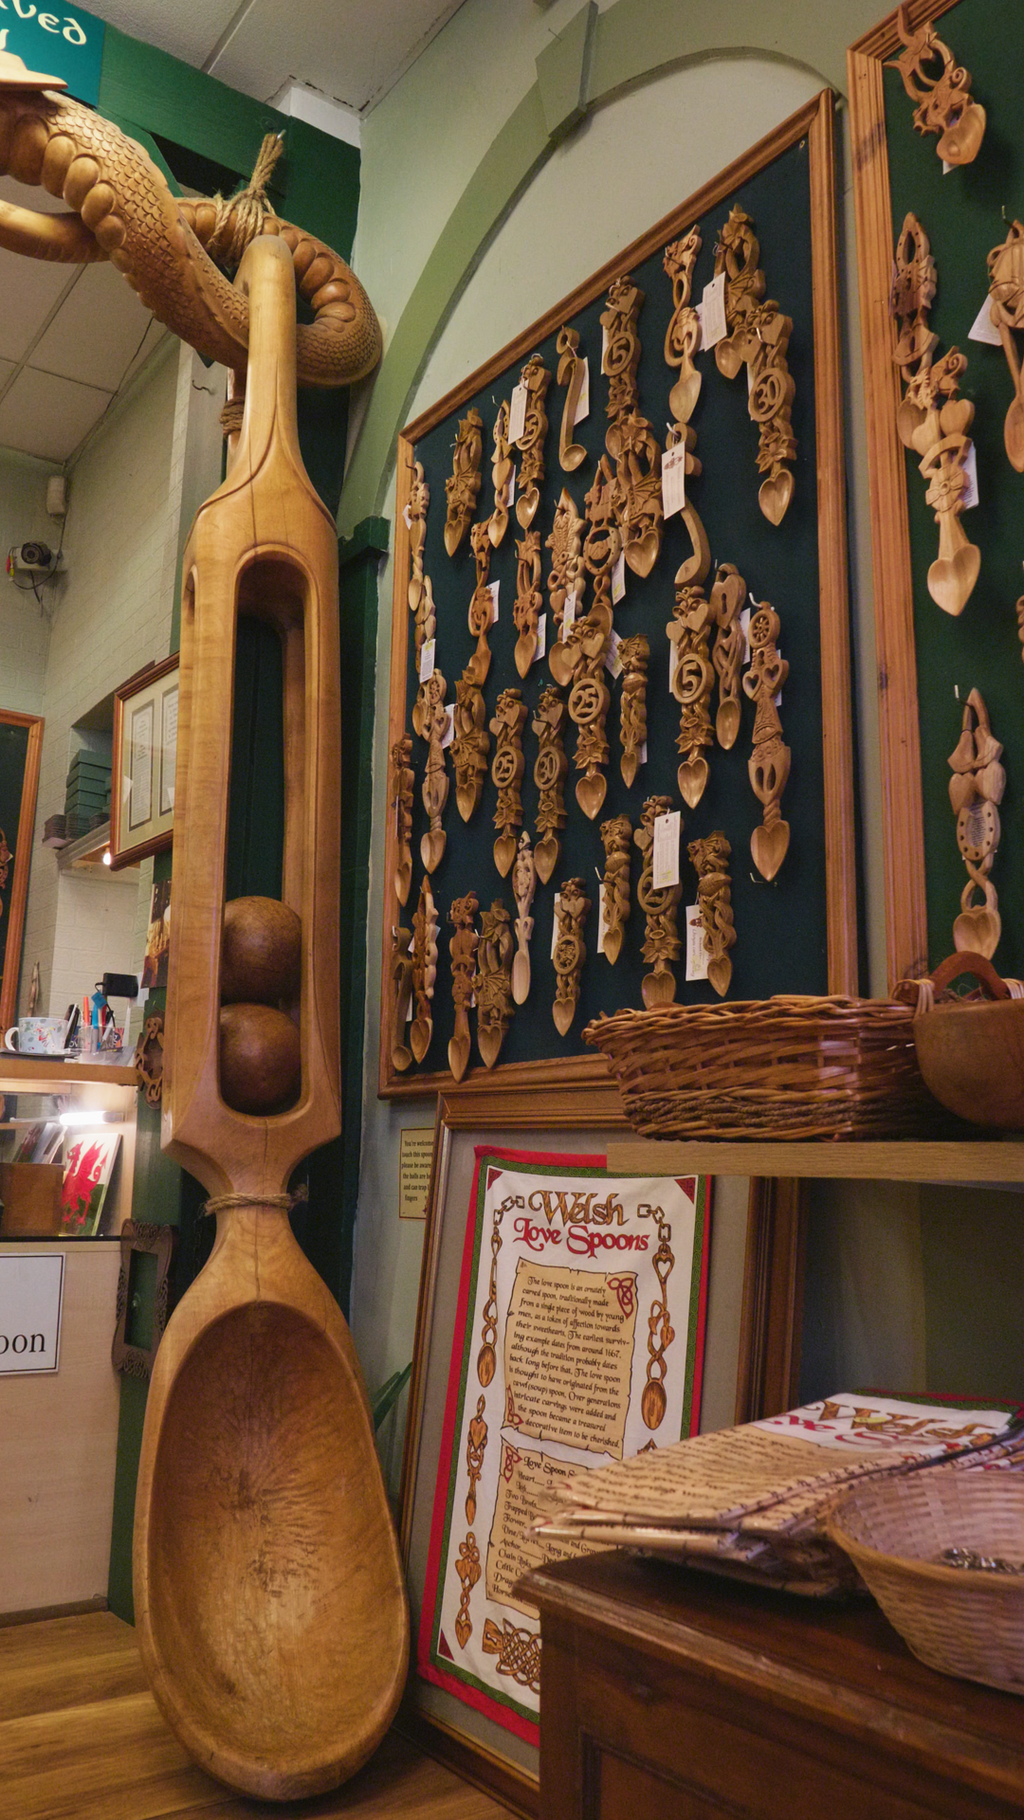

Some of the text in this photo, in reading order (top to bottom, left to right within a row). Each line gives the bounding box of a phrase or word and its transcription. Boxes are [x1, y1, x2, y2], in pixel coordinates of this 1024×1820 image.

[528, 1190, 630, 1226] Welsh
[513, 1218, 650, 1259] Love Spoons
[522, 1288, 609, 1308] carved spoon, traditionally made
[528, 1276, 540, 1285] The
[542, 1280, 552, 1288] love
[554, 1282, 569, 1292] spoon
[584, 1284, 606, 1297] ornately
[518, 1310, 532, 1320] men,
[547, 1315, 561, 1324] token
[563, 1316, 568, 1328] of
[570, 1319, 593, 1330] affection
[595, 1322, 620, 1332] towards
[520, 1298, 534, 1307] from
[541, 1300, 555, 1312] single
[556, 1304, 570, 1314] piece
[572, 1307, 578, 1317] of
[579, 1308, 594, 1316] wood
[596, 1310, 603, 1321] by
[606, 1313, 624, 1324] young
[514, 1331, 524, 1341] ing
[526, 1334, 550, 1345] example
[552, 1339, 565, 1348] dates
[567, 1342, 580, 1351] from
[582, 1345, 603, 1355] around
[516, 1320, 531, 1329] their
[568, 1330, 581, 1340] The
[583, 1333, 604, 1342] earliest
[510, 1354, 620, 1384] back long before that. The love spoon
[511, 1343, 539, 1356] although
[551, 1352, 574, 1362] tradition
[576, 1356, 601, 1370] probably
[602, 1360, 617, 1370] dates
[515, 1367, 539, 1380] thought
[548, 1374, 561, 1384] have
[563, 1378, 592, 1390] originated
[593, 1383, 607, 1394] from
[609, 1387, 619, 1396] the
[514, 1391, 540, 1403] intricate
[542, 1398, 567, 1411] carvings
[569, 1405, 584, 1414] were
[586, 1408, 603, 1418] added
[528, 1383, 548, 1394] (soup)
[568, 1391, 585, 1402] Over
[587, 1396, 621, 1409] generations
[518, 1404, 527, 1413] the
[529, 1408, 547, 1418] spoon
[549, 1412, 571, 1424] became
[579, 1420, 606, 1432] treasured
[525, 1419, 558, 1432] decorative
[559, 1426, 572, 1436] item
[581, 1432, 588, 1441] be
[590, 1435, 620, 1448] cherished.
[524, 1456, 542, 1470] Love
[543, 1463, 566, 1476] Spoon
